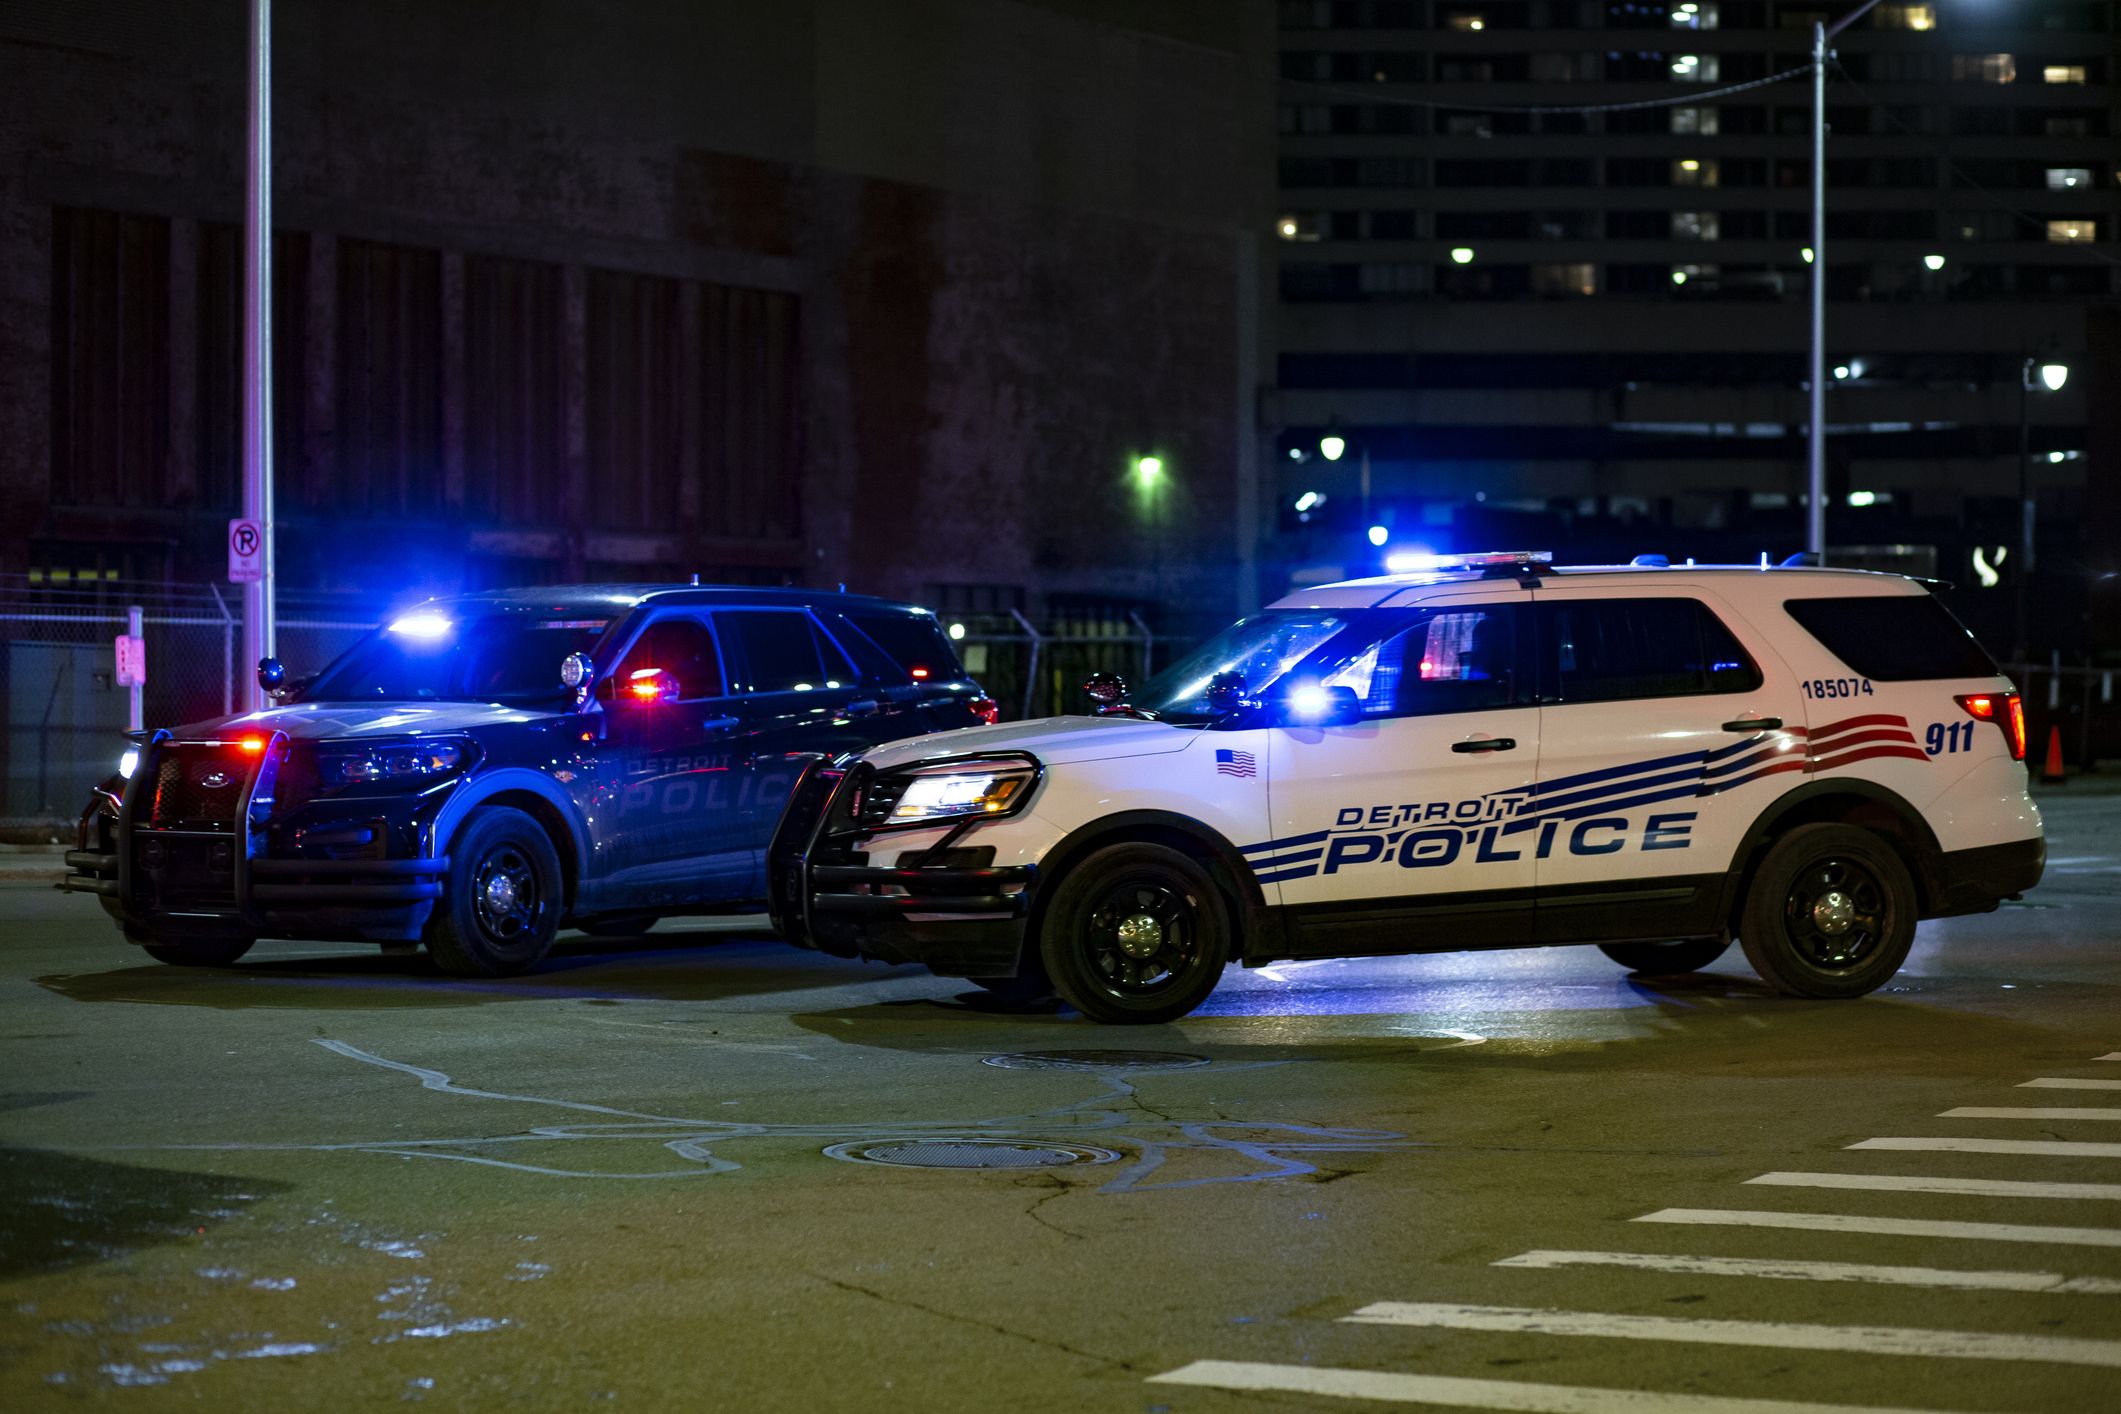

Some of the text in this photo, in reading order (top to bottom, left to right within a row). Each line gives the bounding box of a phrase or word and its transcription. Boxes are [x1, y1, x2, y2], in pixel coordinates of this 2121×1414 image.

[1802, 679, 1873, 699] 185074
[1925, 720, 1974, 755] 911
[627, 754, 731, 774] DETROIT
[618, 773, 790, 818] POLIC
[1336, 797, 1528, 826] DETROIT
[1322, 812, 1698, 874] POLICE
